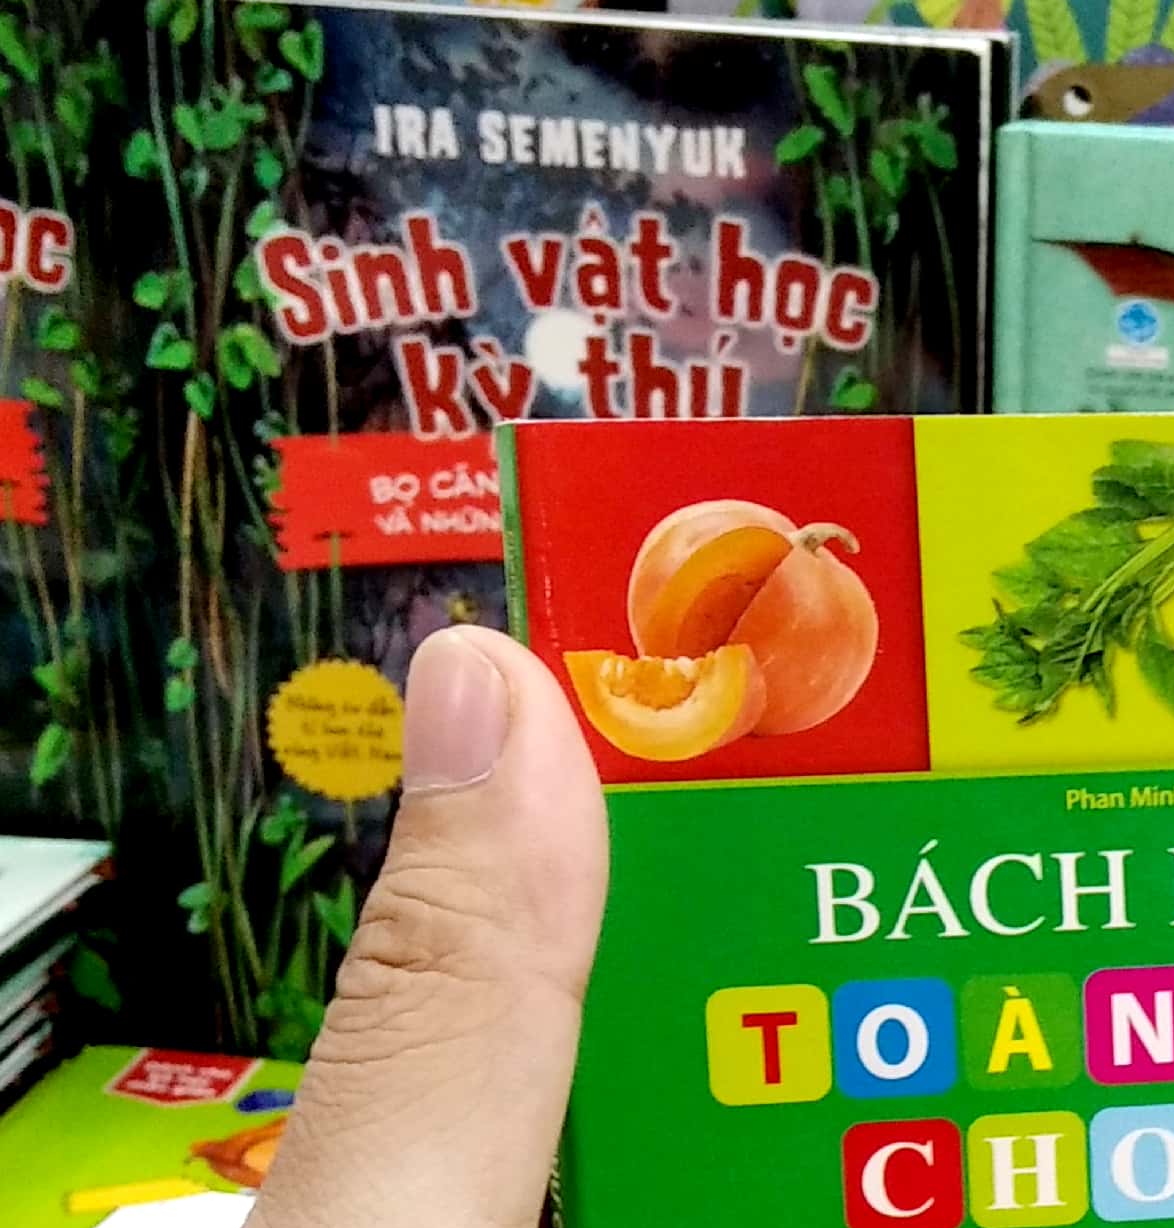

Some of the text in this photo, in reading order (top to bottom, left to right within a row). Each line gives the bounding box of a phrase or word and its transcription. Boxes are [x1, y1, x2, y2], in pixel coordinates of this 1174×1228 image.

[372, 104, 747, 179] IRA SEMENYUK
[260, 205, 877, 351] Sinh vật học
[1065, 788, 1125, 811] Phan
[804, 838, 1137, 944] BÁCH
